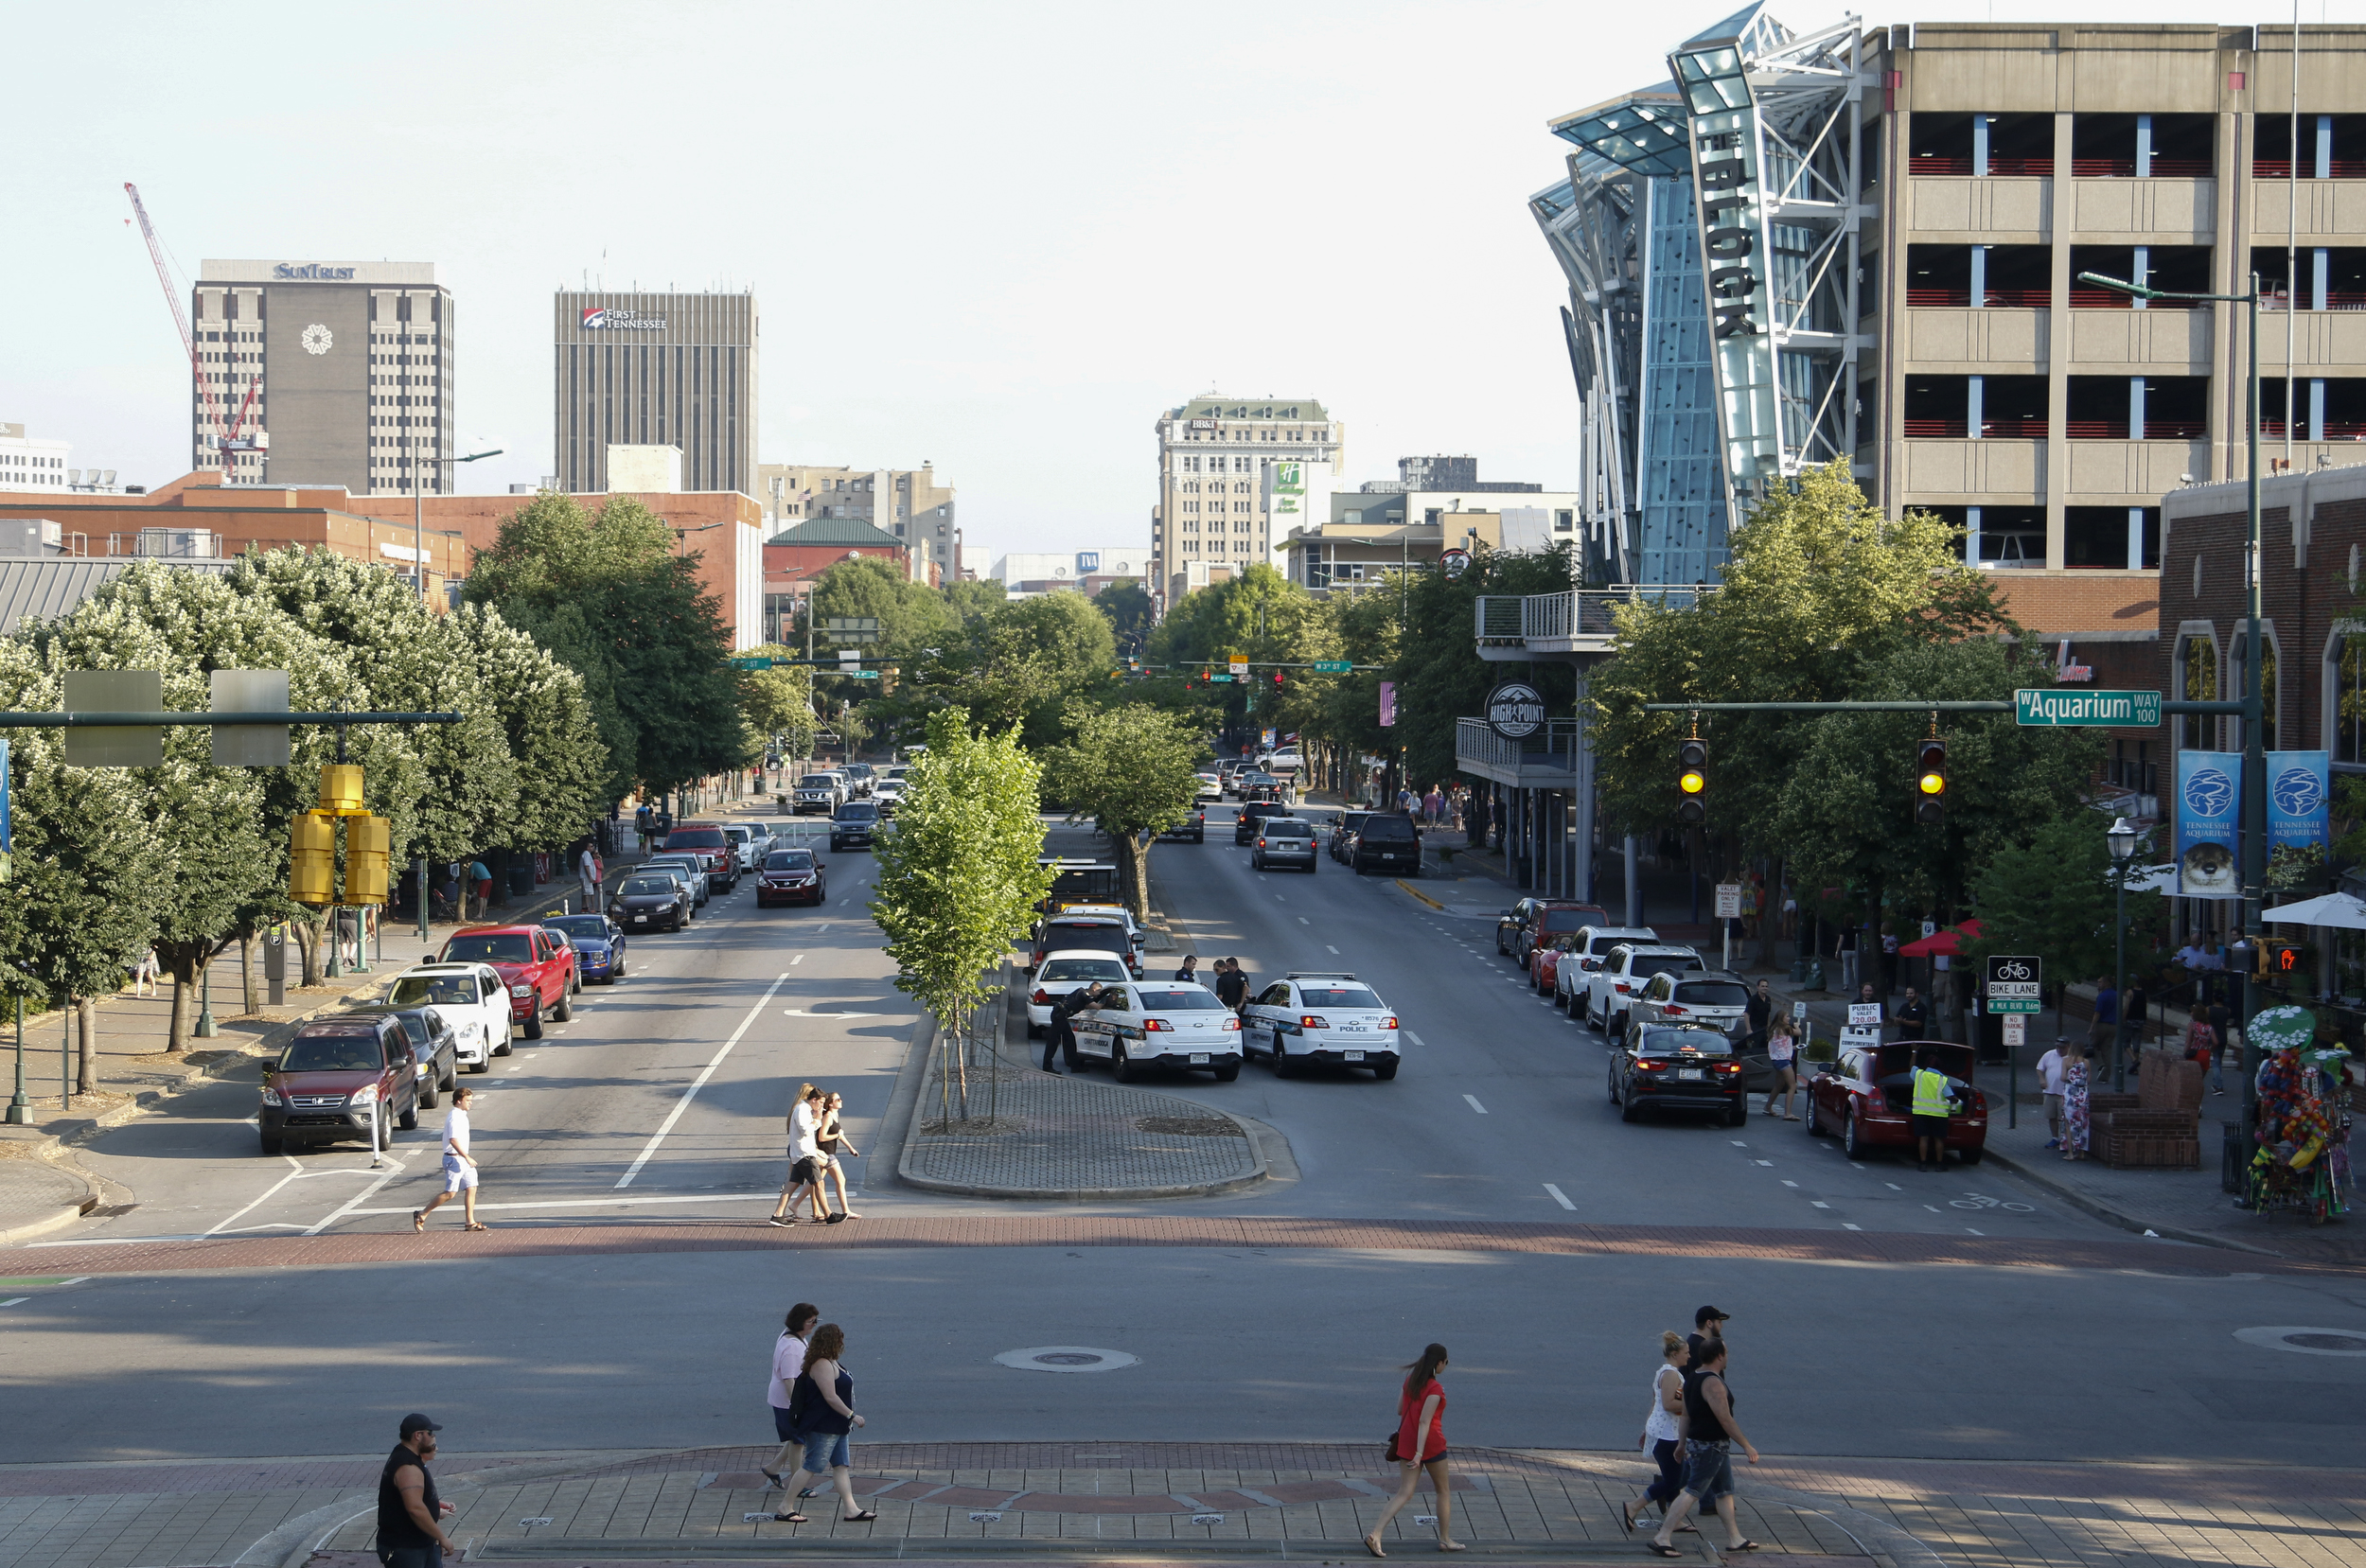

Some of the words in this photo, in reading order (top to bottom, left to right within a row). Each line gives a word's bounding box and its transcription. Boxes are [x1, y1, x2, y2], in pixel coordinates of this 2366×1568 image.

[1700, 158, 1757, 339] BLOCK
[606, 308, 636, 319] FIRST
[606, 319, 667, 328] TENNESSEE
[1192, 419, 1216, 429] BB&T
[1081, 555, 1098, 567] TVA
[1490, 704, 1511, 722] HIGH
[1518, 704, 1545, 722] POINT
[2021, 692, 2031, 705] W
[2029, 692, 2130, 724] Aquarium
[2133, 695, 2159, 707] WAY
[2136, 709, 2156, 722] 100
[2273, 829, 2321, 837] AQUARIUM
[1990, 984, 2009, 994] BIKE
[2014, 984, 2037, 994] LANE
[1084, 1038, 1109, 1048] CHATTANOOGA
